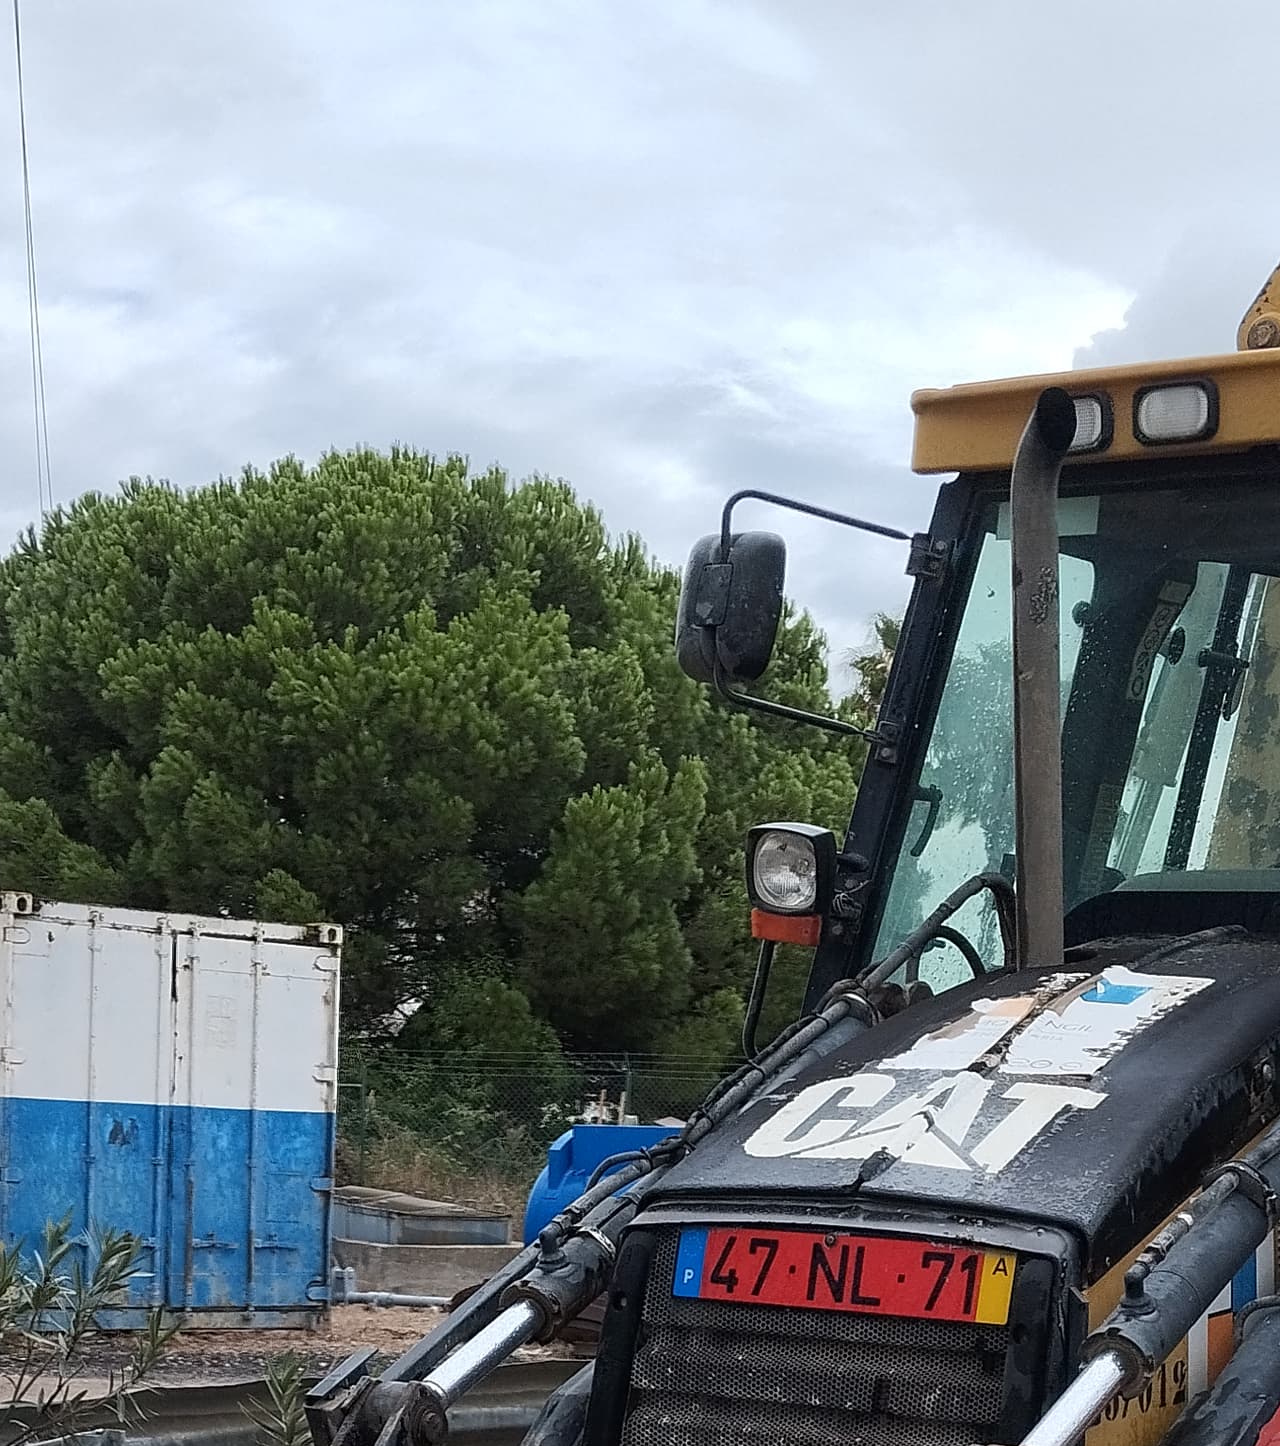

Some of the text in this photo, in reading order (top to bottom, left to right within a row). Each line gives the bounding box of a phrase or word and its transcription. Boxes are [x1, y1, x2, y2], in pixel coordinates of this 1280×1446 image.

[743, 1070, 1109, 1175] CAT
[683, 1268, 694, 1284] P
[992, 1257, 1009, 1277] A
